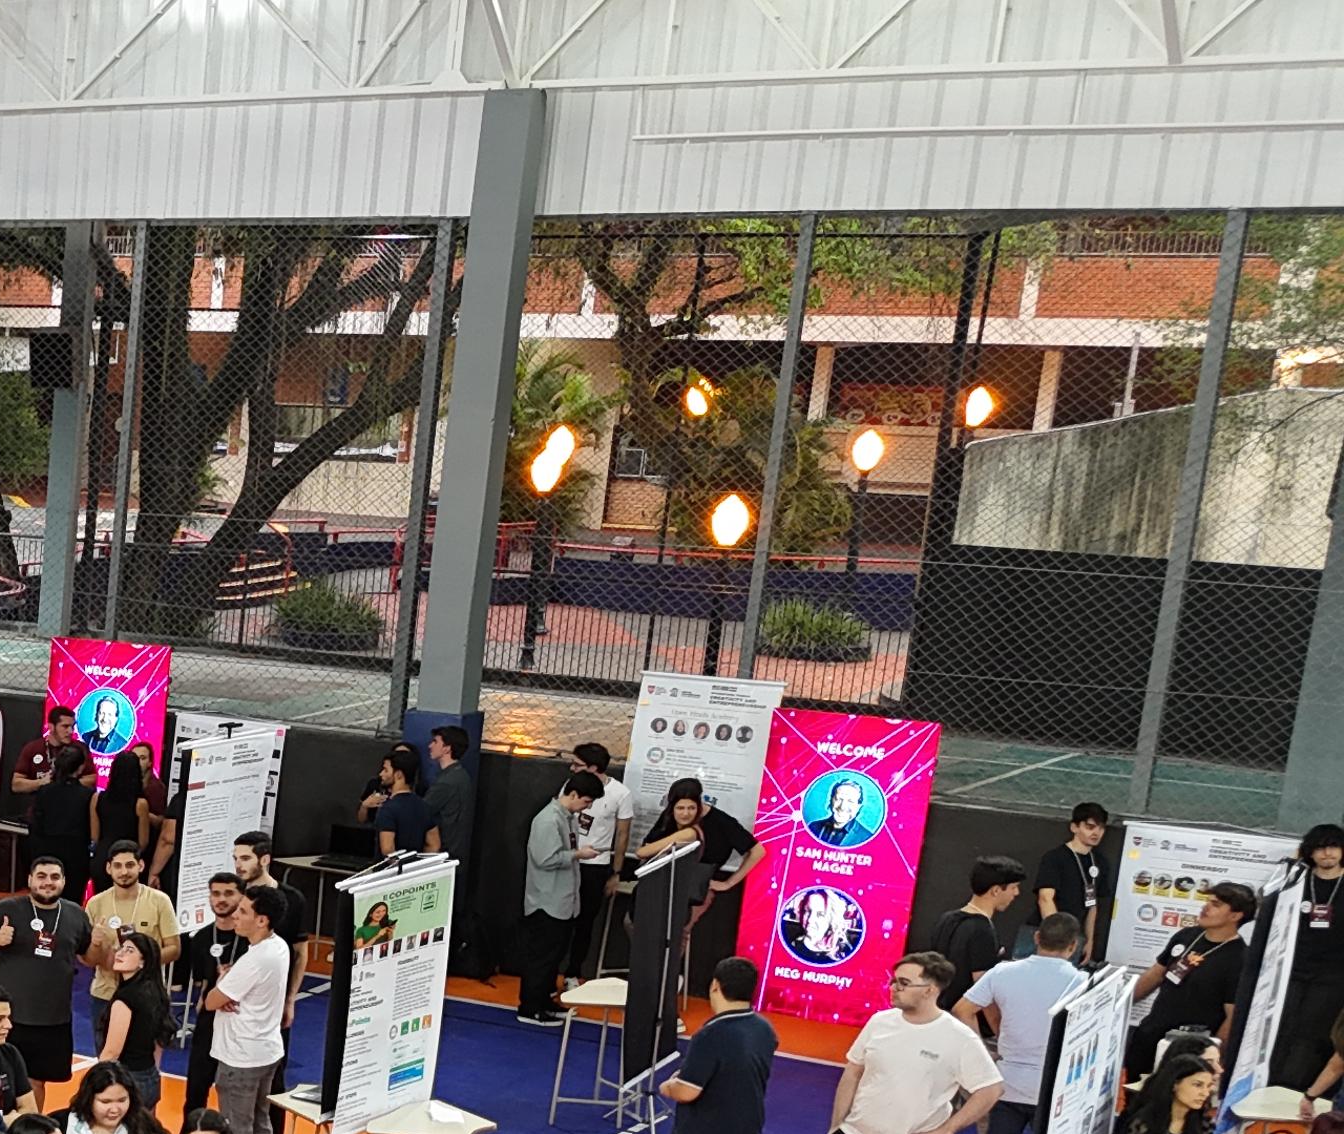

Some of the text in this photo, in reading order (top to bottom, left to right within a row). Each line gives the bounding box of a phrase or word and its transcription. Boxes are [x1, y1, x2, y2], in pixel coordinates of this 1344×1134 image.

[85, 665, 133, 677] WELCOME
[817, 741, 885, 760] WELCOME
[796, 847, 872, 866] SAM HUNTER
[813, 862, 854, 875] MAGEE
[383, 882, 437, 901] ECOPOINTS
[775, 967, 852, 988] MEG MURPHY
